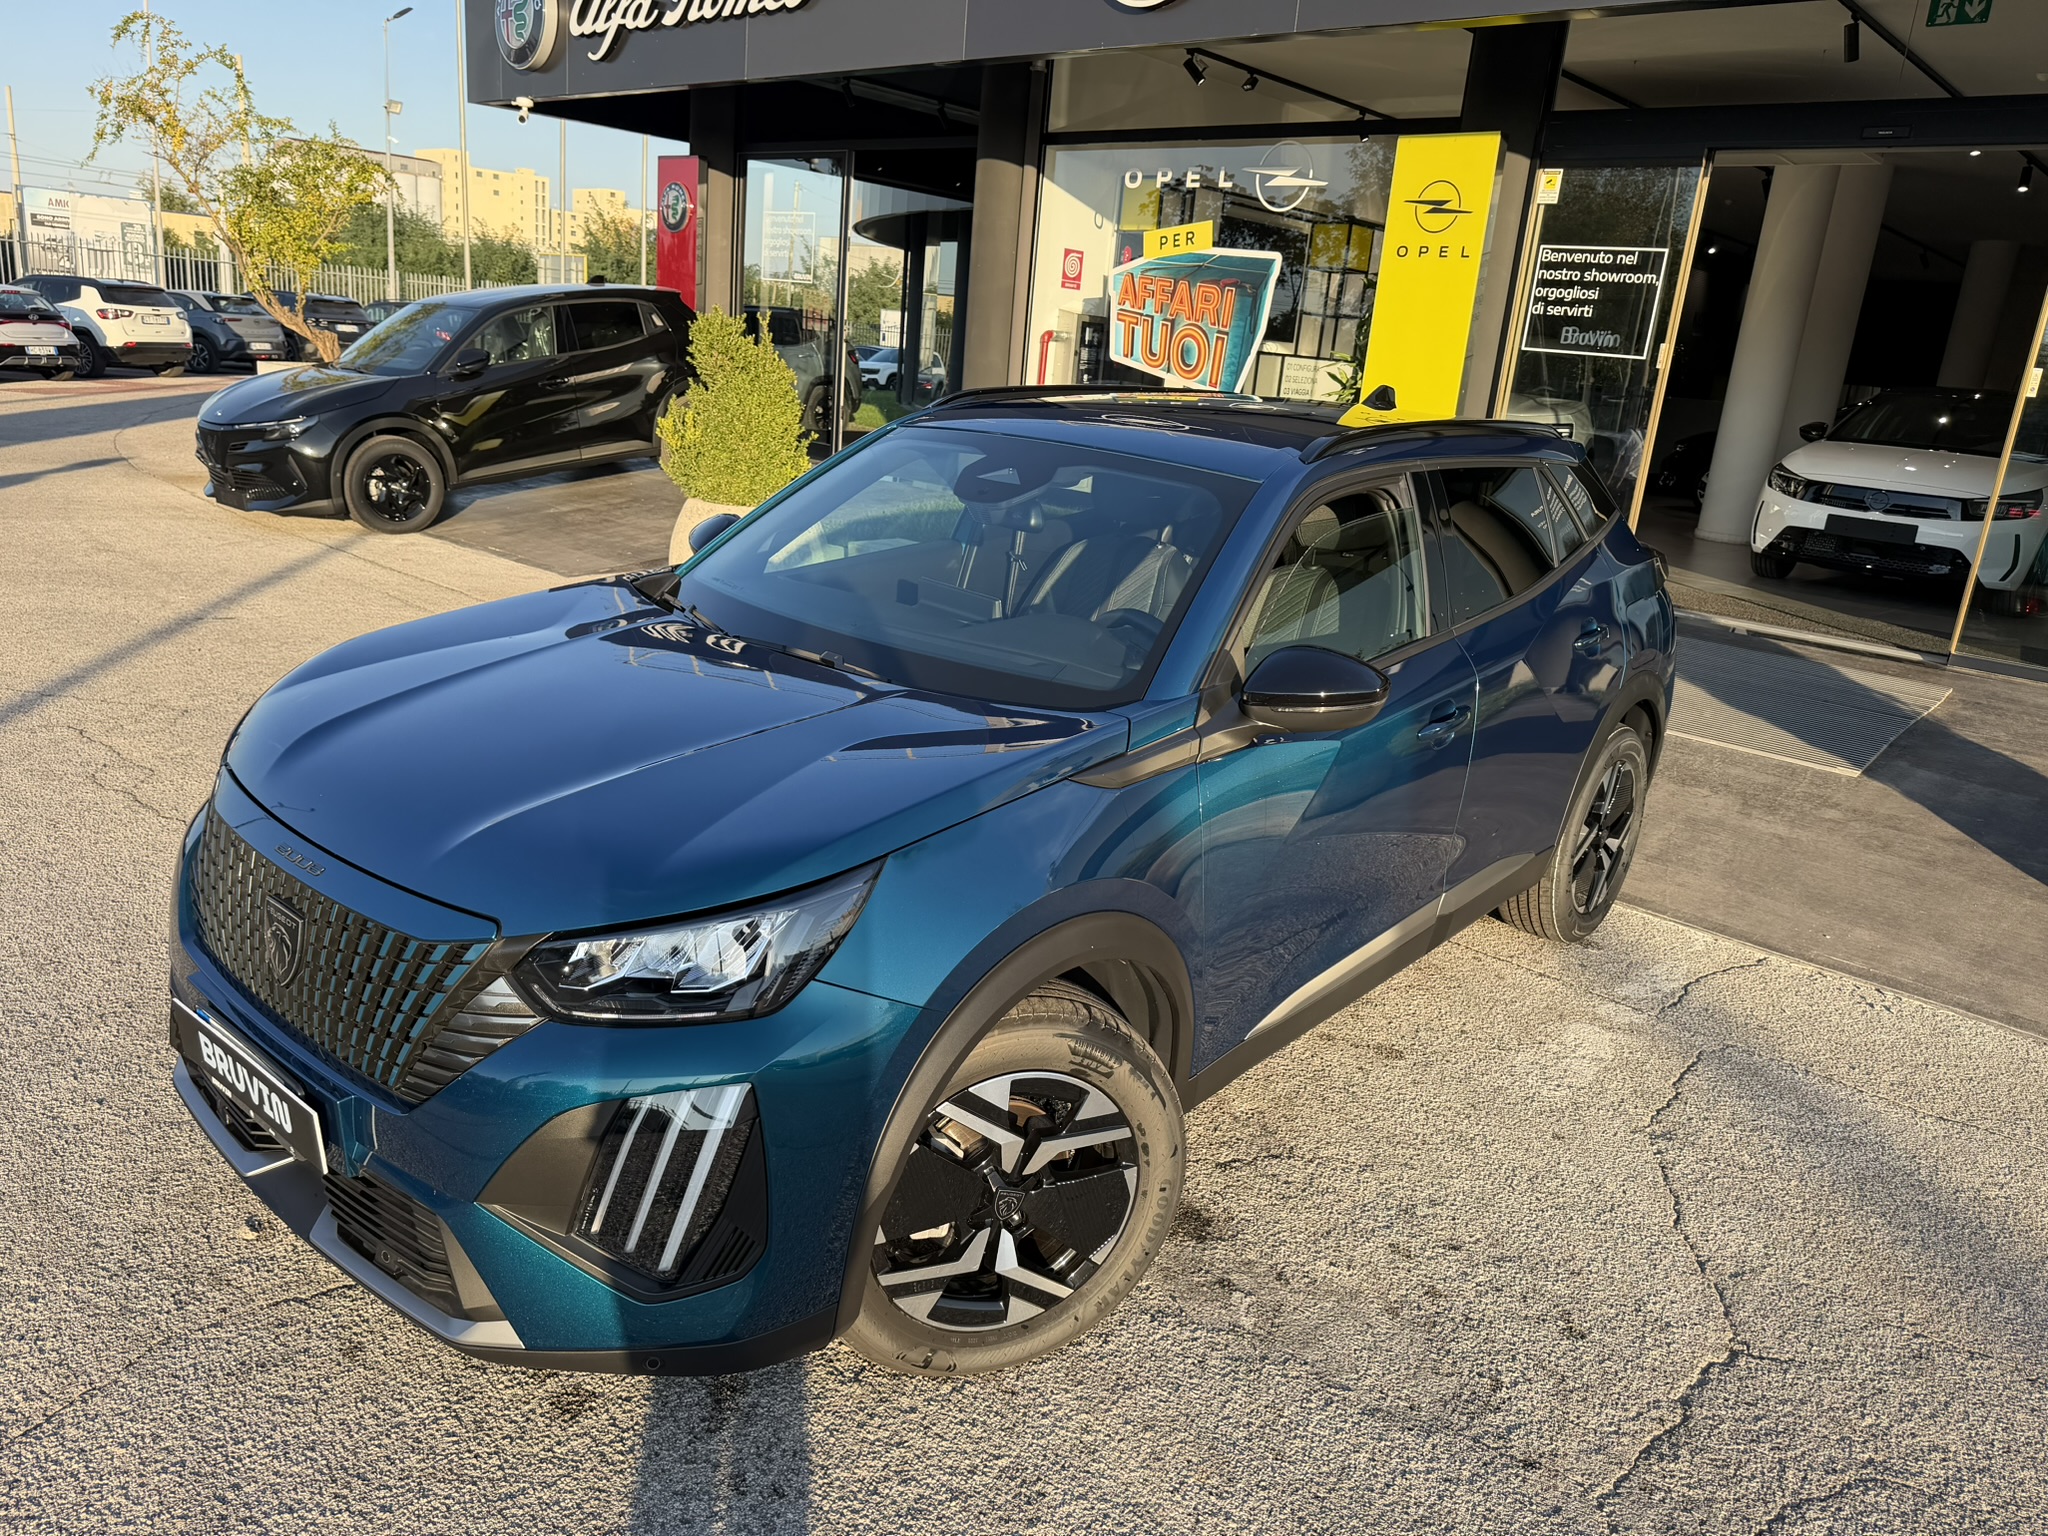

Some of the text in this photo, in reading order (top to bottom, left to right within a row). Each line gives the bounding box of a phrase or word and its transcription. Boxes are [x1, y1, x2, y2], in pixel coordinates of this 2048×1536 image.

[1124, 166, 1234, 190] OPEL
[1159, 231, 1196, 250] PER
[1396, 245, 1470, 258] OPEL
[1541, 249, 1639, 265] Benvenuto nel
[1538, 268, 1660, 286] nostro showroom,
[1117, 271, 1237, 331] AFFARI
[1535, 285, 1600, 301] orgogliosi
[1531, 301, 1594, 317] di servirti
[1117, 310, 1228, 390] TUOI
[274, 841, 327, 877] 2008
[267, 904, 297, 930] PEUGEOT
[198, 1030, 293, 1134] BRUVIN
[1094, 1178, 1172, 1315] GOODYEAR
